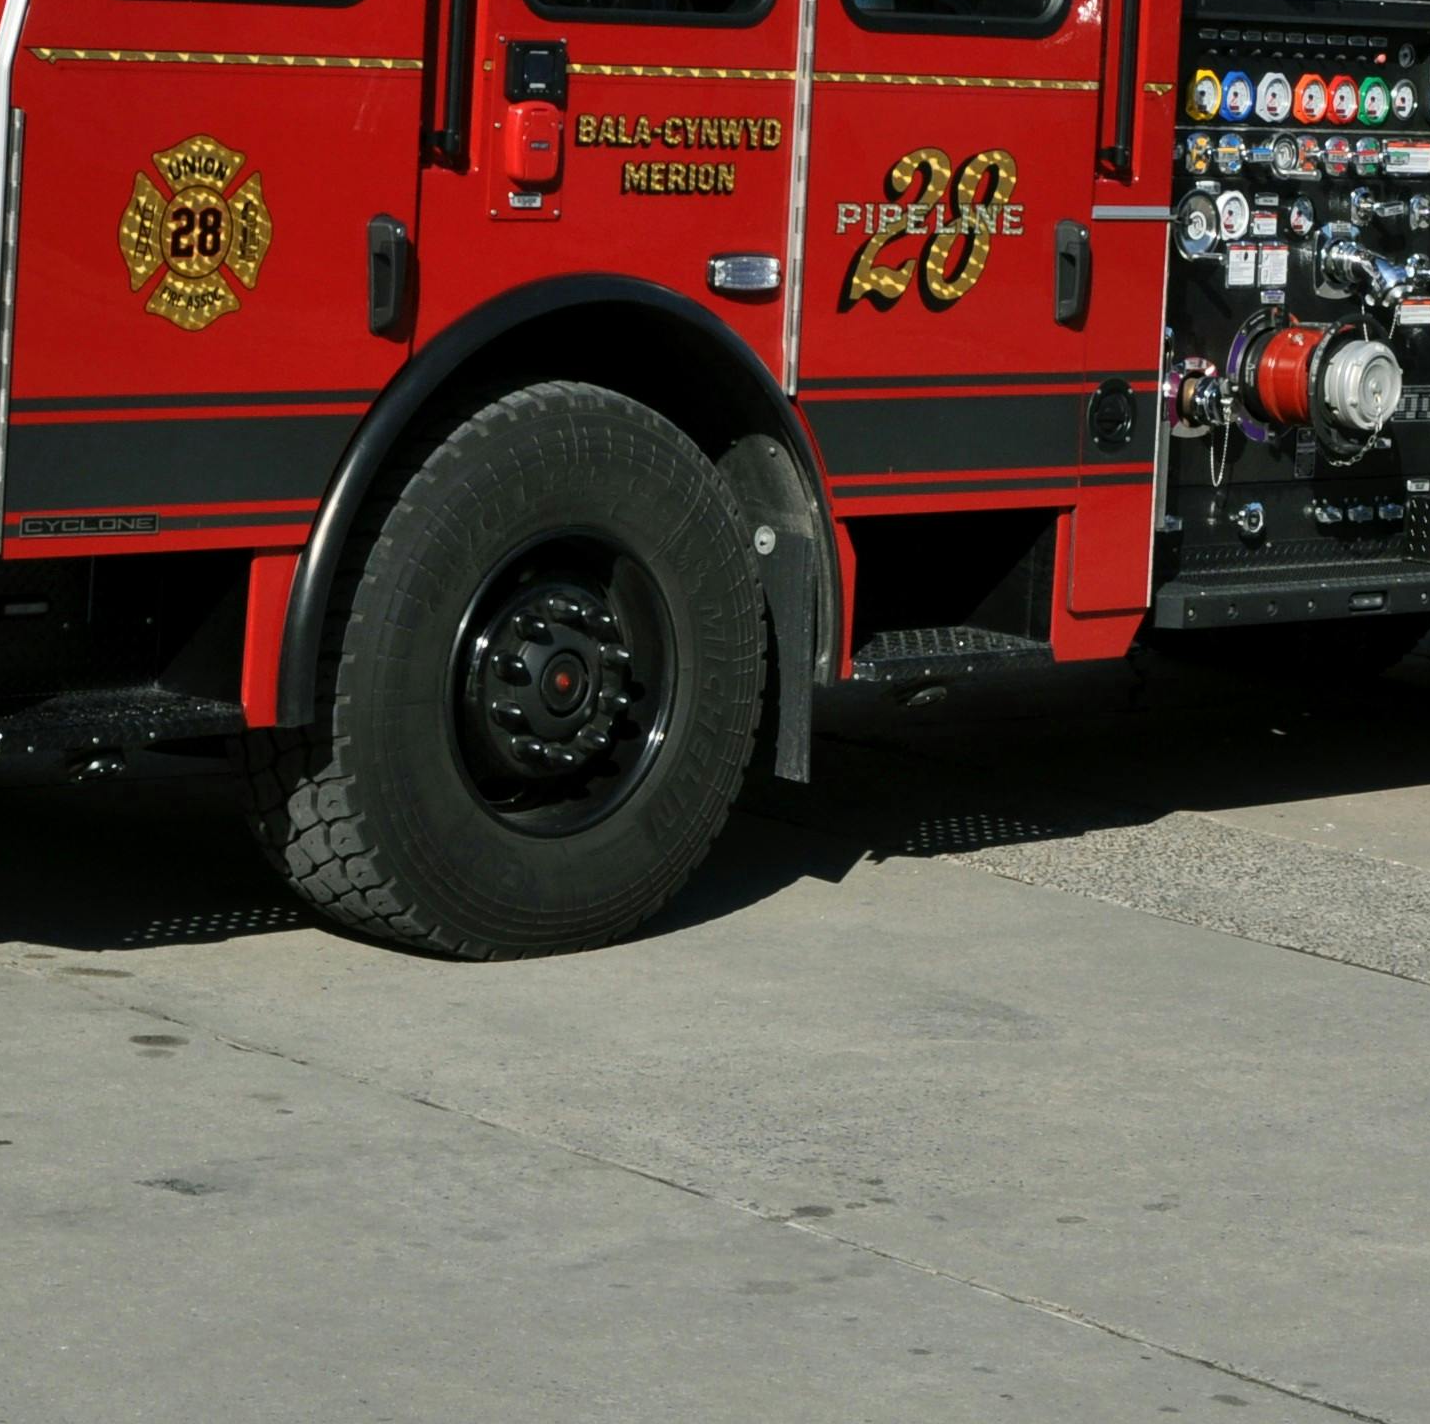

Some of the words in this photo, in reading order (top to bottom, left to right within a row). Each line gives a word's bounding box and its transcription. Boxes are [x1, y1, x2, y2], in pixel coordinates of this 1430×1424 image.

[575, 113, 783, 149] BALA-CYNWYD
[167, 156, 228, 181] UNION
[621, 161, 737, 195] MERION
[171, 206, 222, 258] 28
[835, 202, 1026, 236] PIPELINE
[836, 146, 1018, 314] 28
[160, 287, 184, 307] FIRE
[24, 517, 154, 534] CYCLONE
[650, 600, 726, 839] MICHELIN
